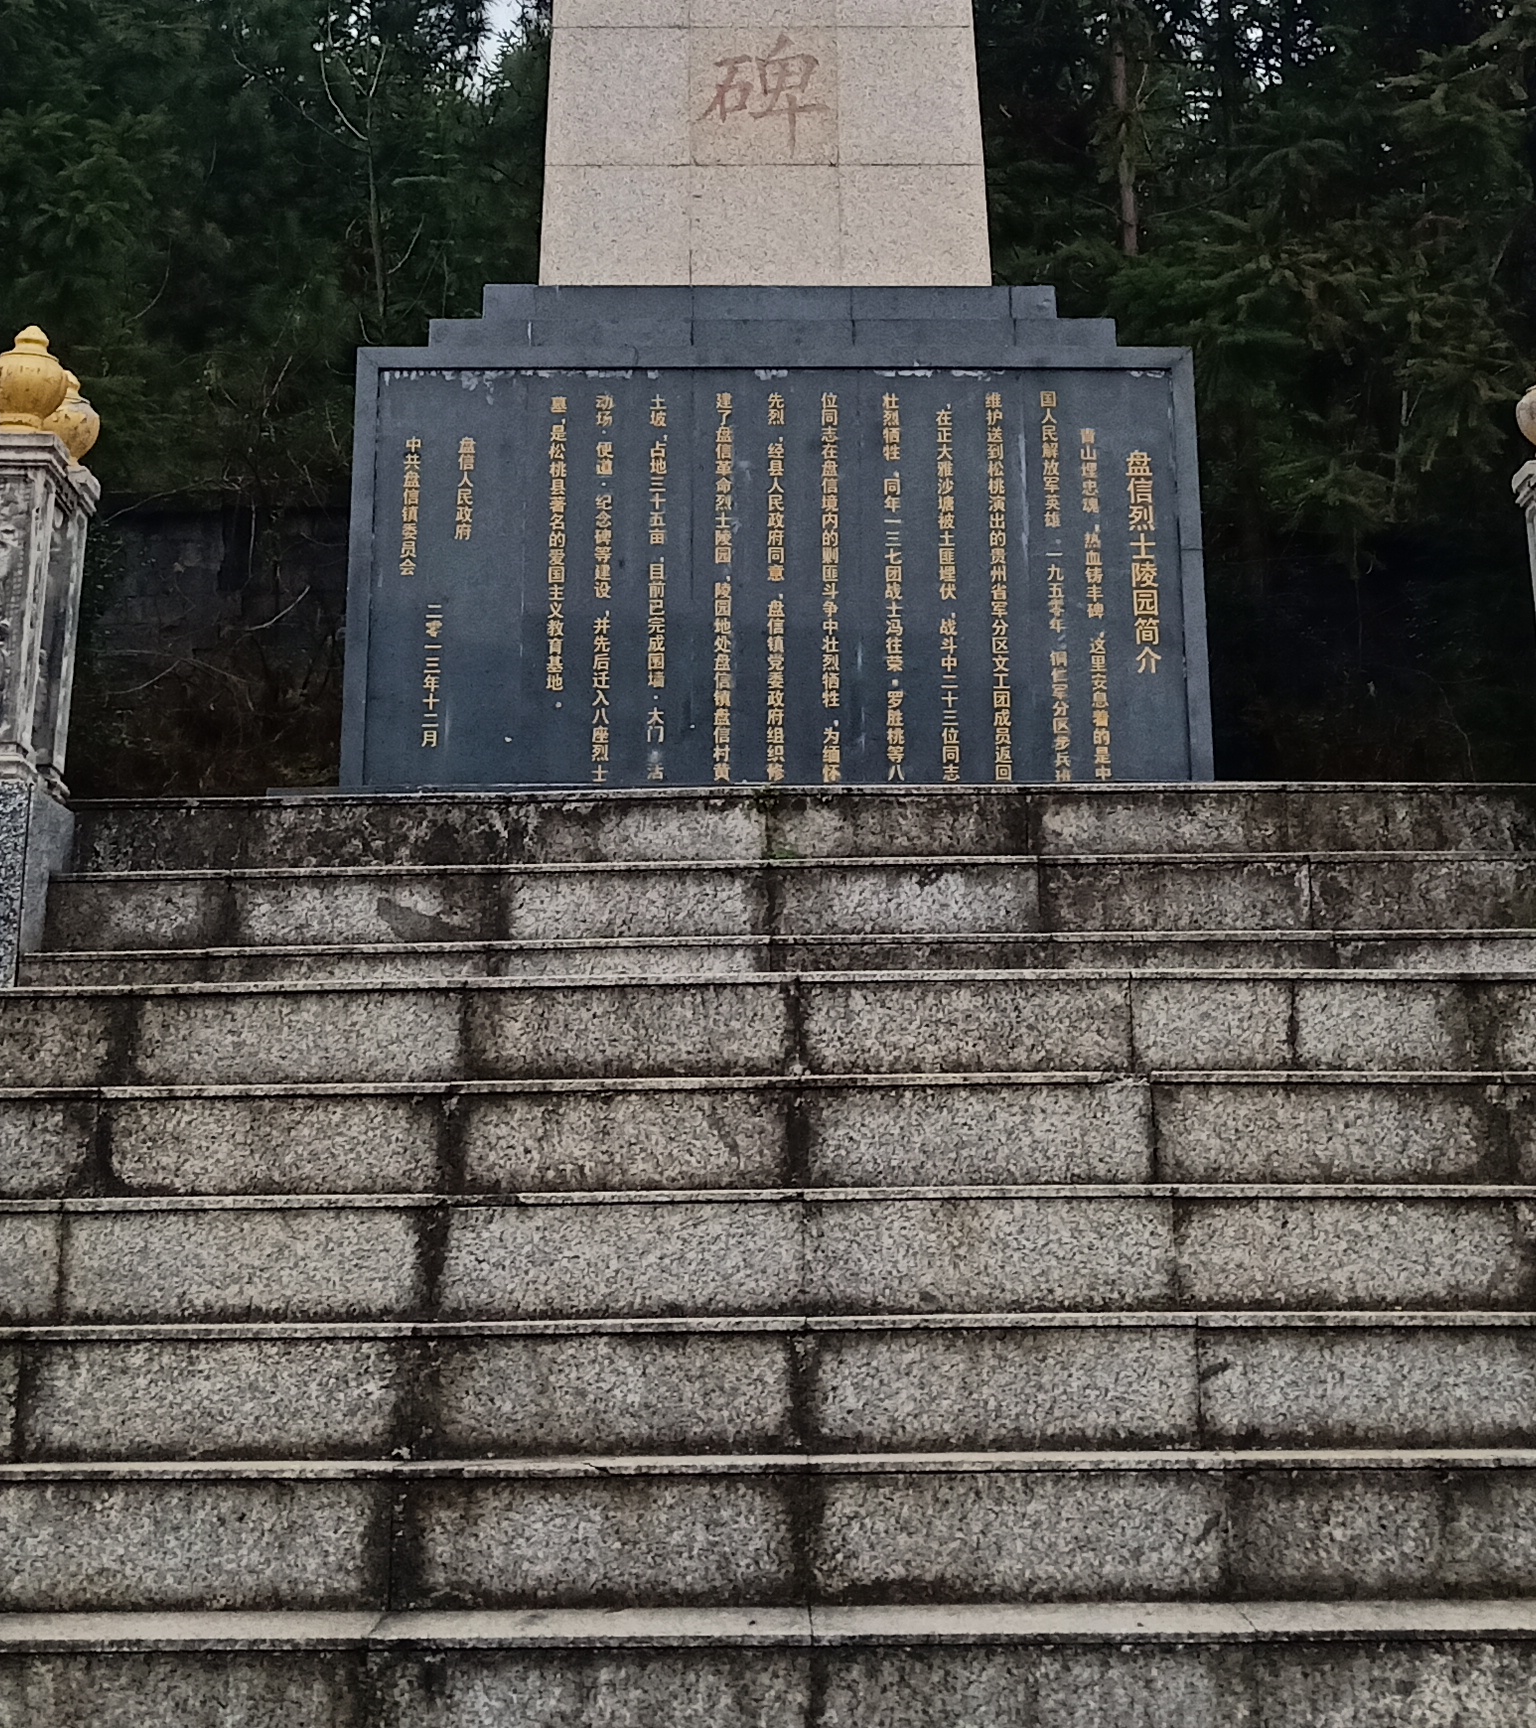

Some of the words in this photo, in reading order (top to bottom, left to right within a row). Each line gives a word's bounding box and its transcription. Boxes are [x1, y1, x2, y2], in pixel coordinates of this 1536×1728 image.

[399, 437, 421, 576] 中共盘信镇委员会
[454, 437, 476, 540] 盘信人民政府
[1125, 449, 1162, 674] 盘信烈士陵园简介
[421, 604, 443, 747] 二零一三年十二月
